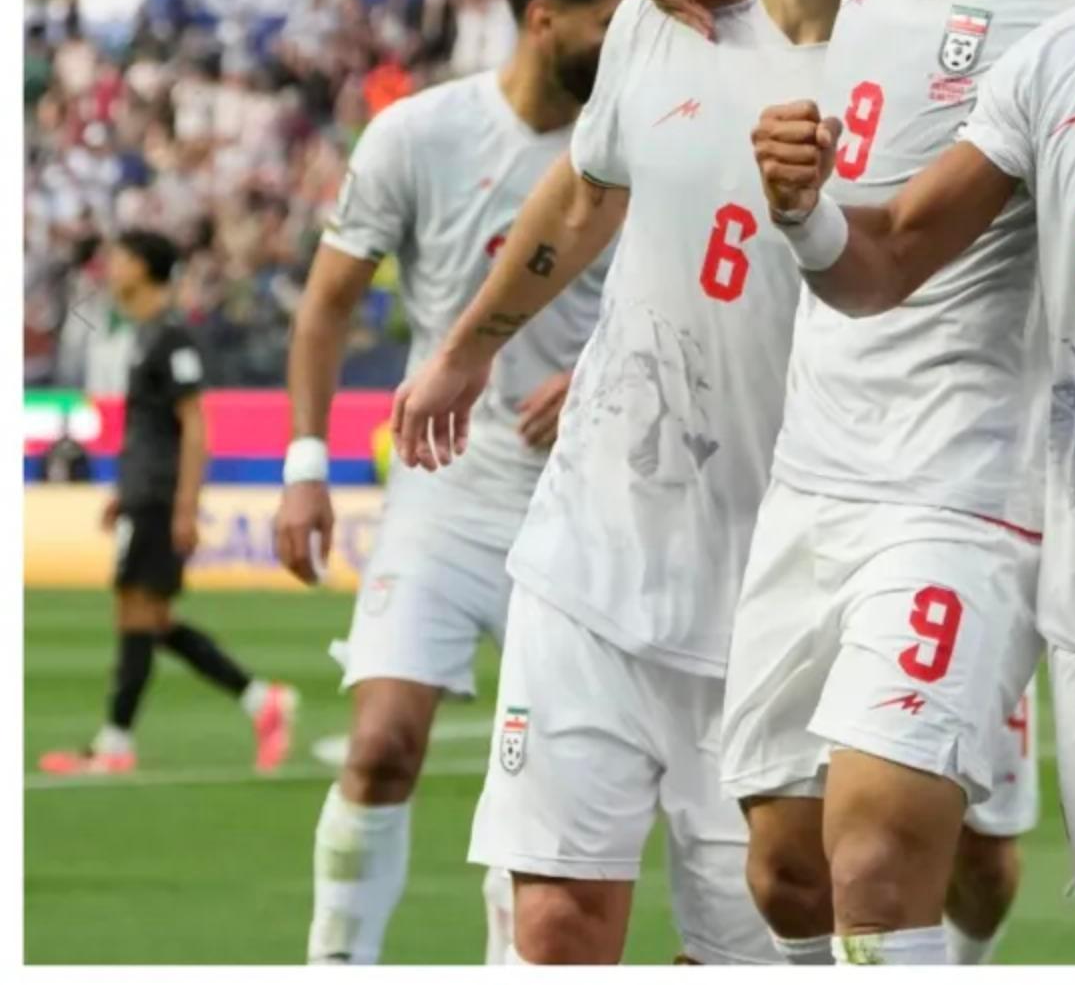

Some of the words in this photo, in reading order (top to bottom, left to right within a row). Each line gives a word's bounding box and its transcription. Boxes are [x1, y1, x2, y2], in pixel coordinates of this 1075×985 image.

[833, 81, 884, 181] 9
[700, 203, 757, 303] 6
[899, 586, 963, 683] 9
